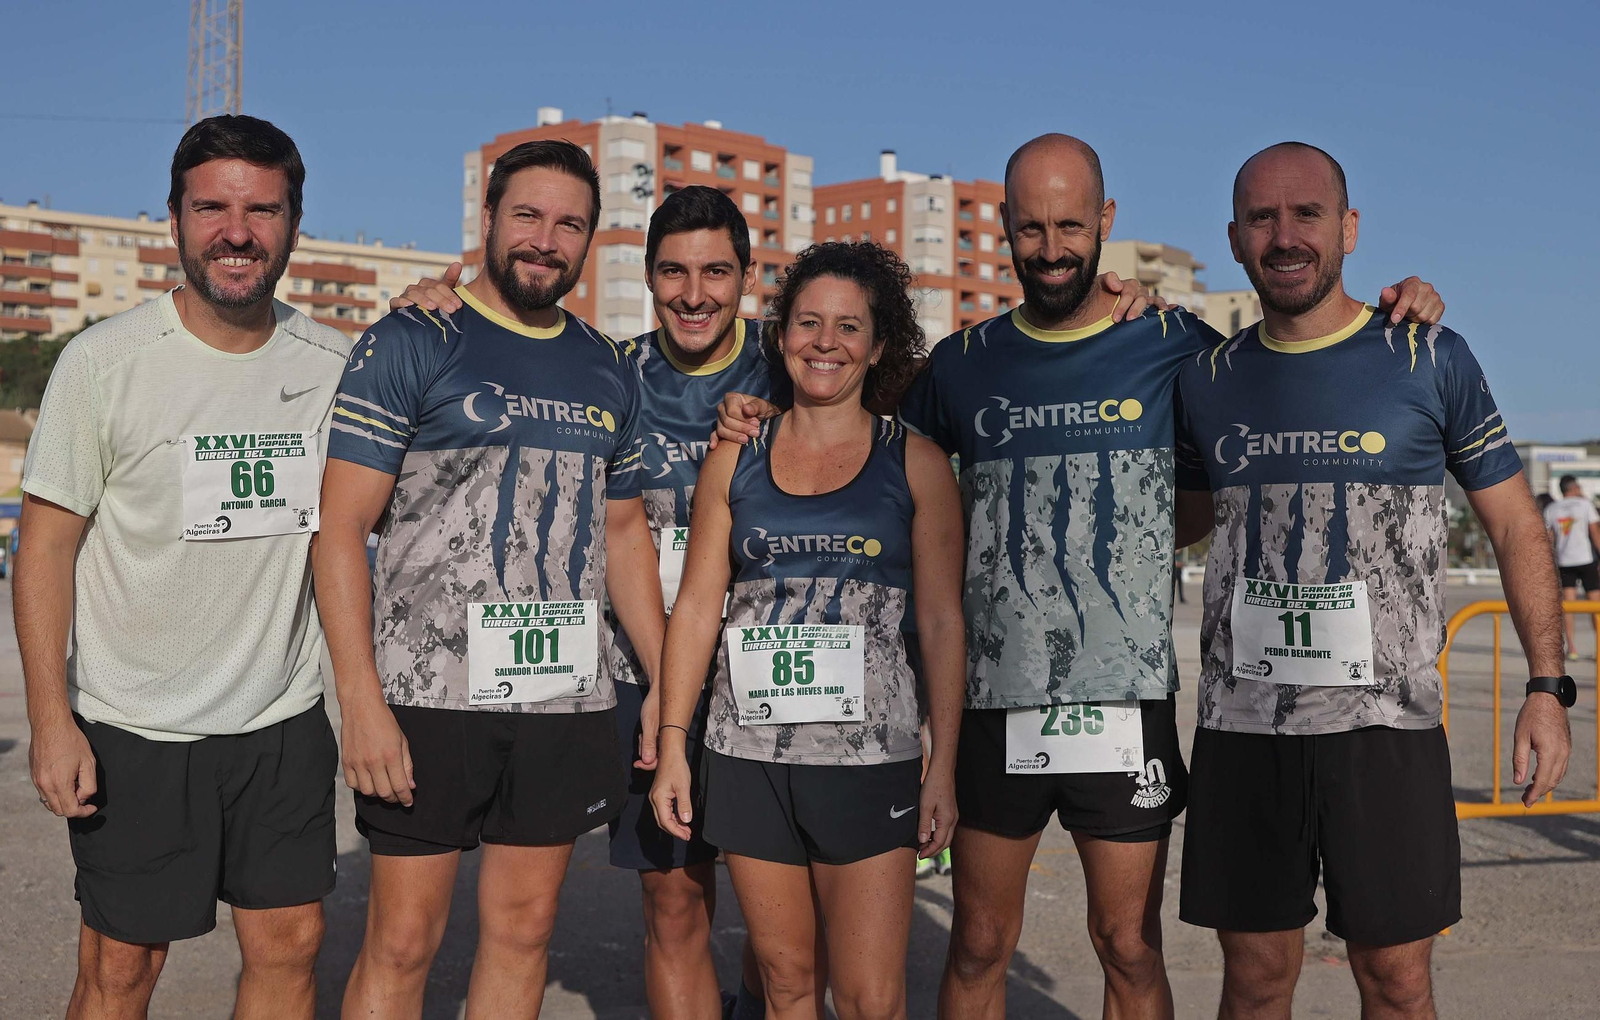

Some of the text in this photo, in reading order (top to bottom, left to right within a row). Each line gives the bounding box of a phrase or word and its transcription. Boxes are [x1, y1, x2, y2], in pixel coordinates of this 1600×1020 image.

[556, 426, 616, 446] COMMUNITY
[1065, 425, 1142, 438] COMMUNITY
[194, 434, 256, 450] XXVI
[197, 449, 303, 460] VIRGEN DEL PILAR
[1303, 459, 1383, 467] COMMUNITY
[231, 460, 275, 498] 66
[221, 498, 286, 510] ANTONIO GARCIA
[817, 556, 876, 566] COMMUNITY
[1245, 580, 1299, 599] XXVI
[1301, 584, 1352, 592] CARRERA
[1301, 591, 1352, 599] POPULAR
[1246, 595, 1352, 609] VIRGEN DEL PILAR
[482, 603, 540, 617] XXVI
[484, 617, 583, 627] VIRGEN DEL PILAR
[740, 626, 798, 641] XXVI
[1278, 611, 1312, 647] 11
[509, 628, 559, 665] 101
[744, 641, 781, 651] VIRGEN
[813, 640, 848, 649] PILAR
[1264, 647, 1331, 659] PEDRO BELMONTE
[495, 665, 574, 676] SALVADOR LLONGARRIU
[772, 651, 815, 686] 85
[748, 686, 844, 699] MARIA DE LAS NIEVES HARO
[1040, 703, 1104, 736] 235
